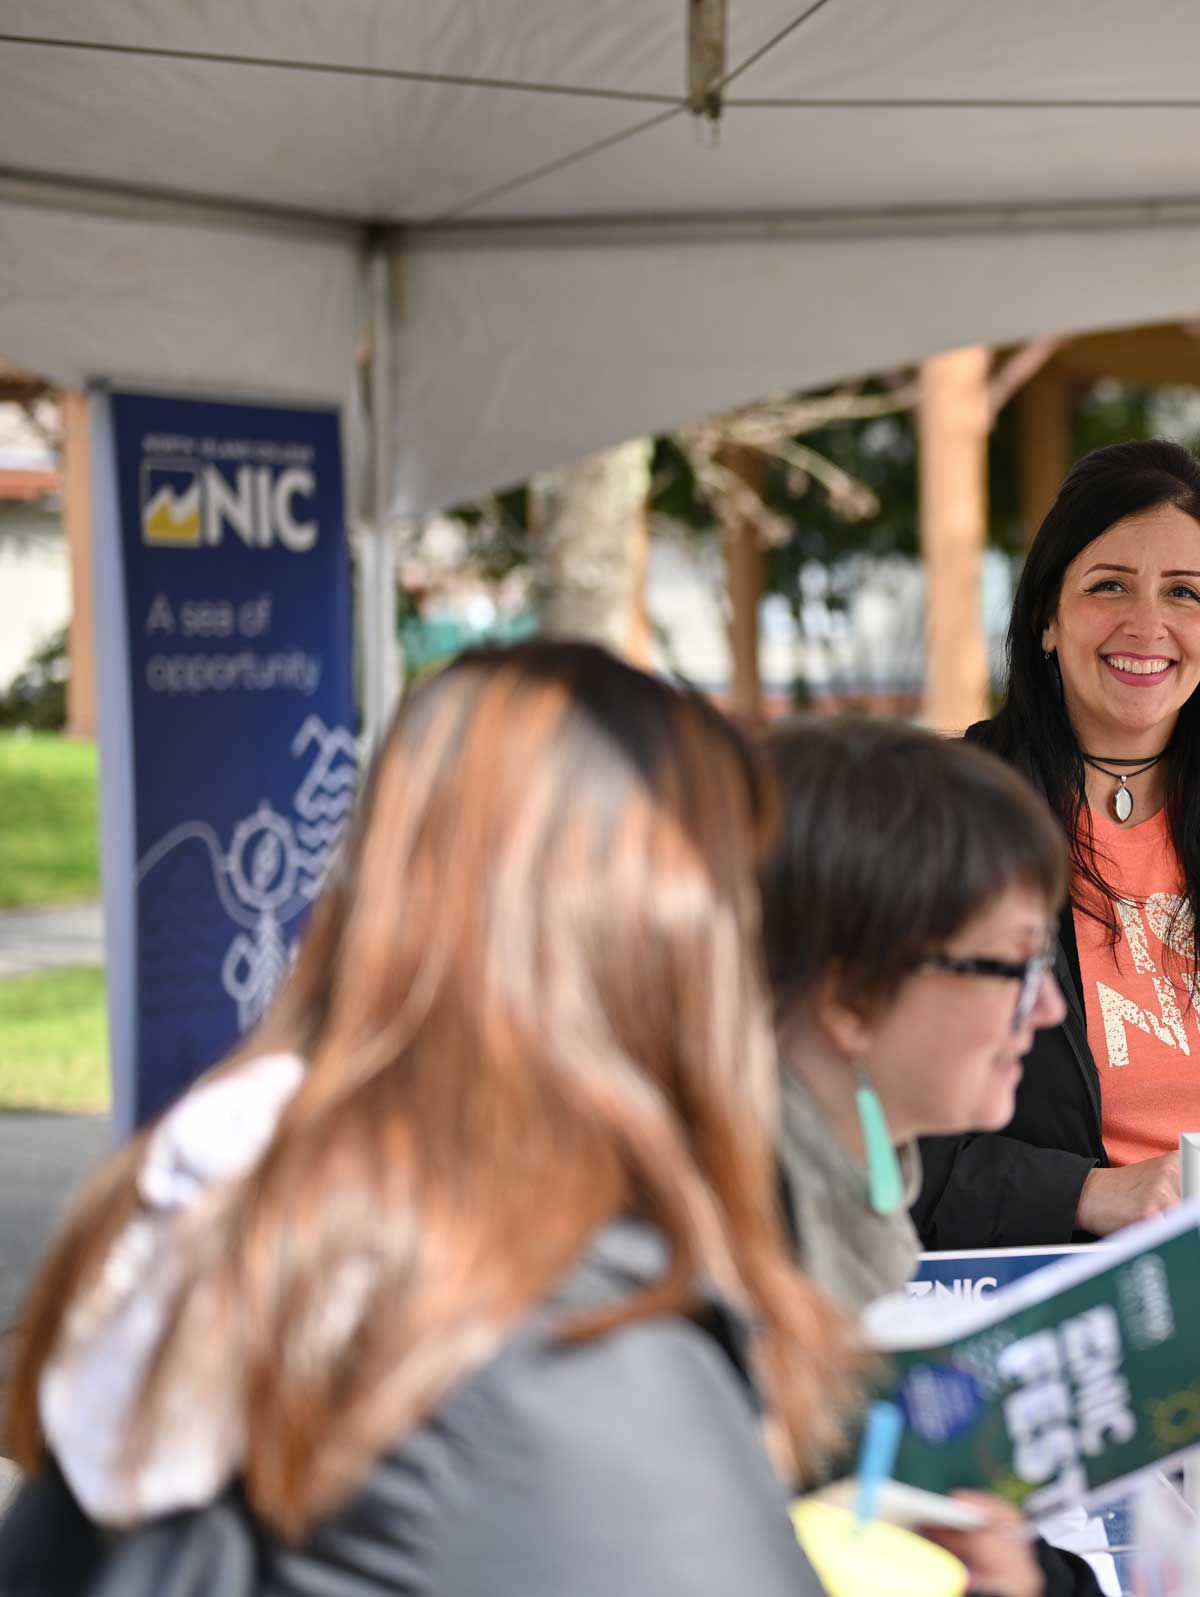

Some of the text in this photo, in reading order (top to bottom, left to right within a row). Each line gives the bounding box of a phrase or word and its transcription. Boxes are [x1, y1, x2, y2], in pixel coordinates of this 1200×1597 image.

[203, 461, 317, 552] NIC
[147, 592, 271, 638] A sea of
[146, 651, 321, 696] opportunity
